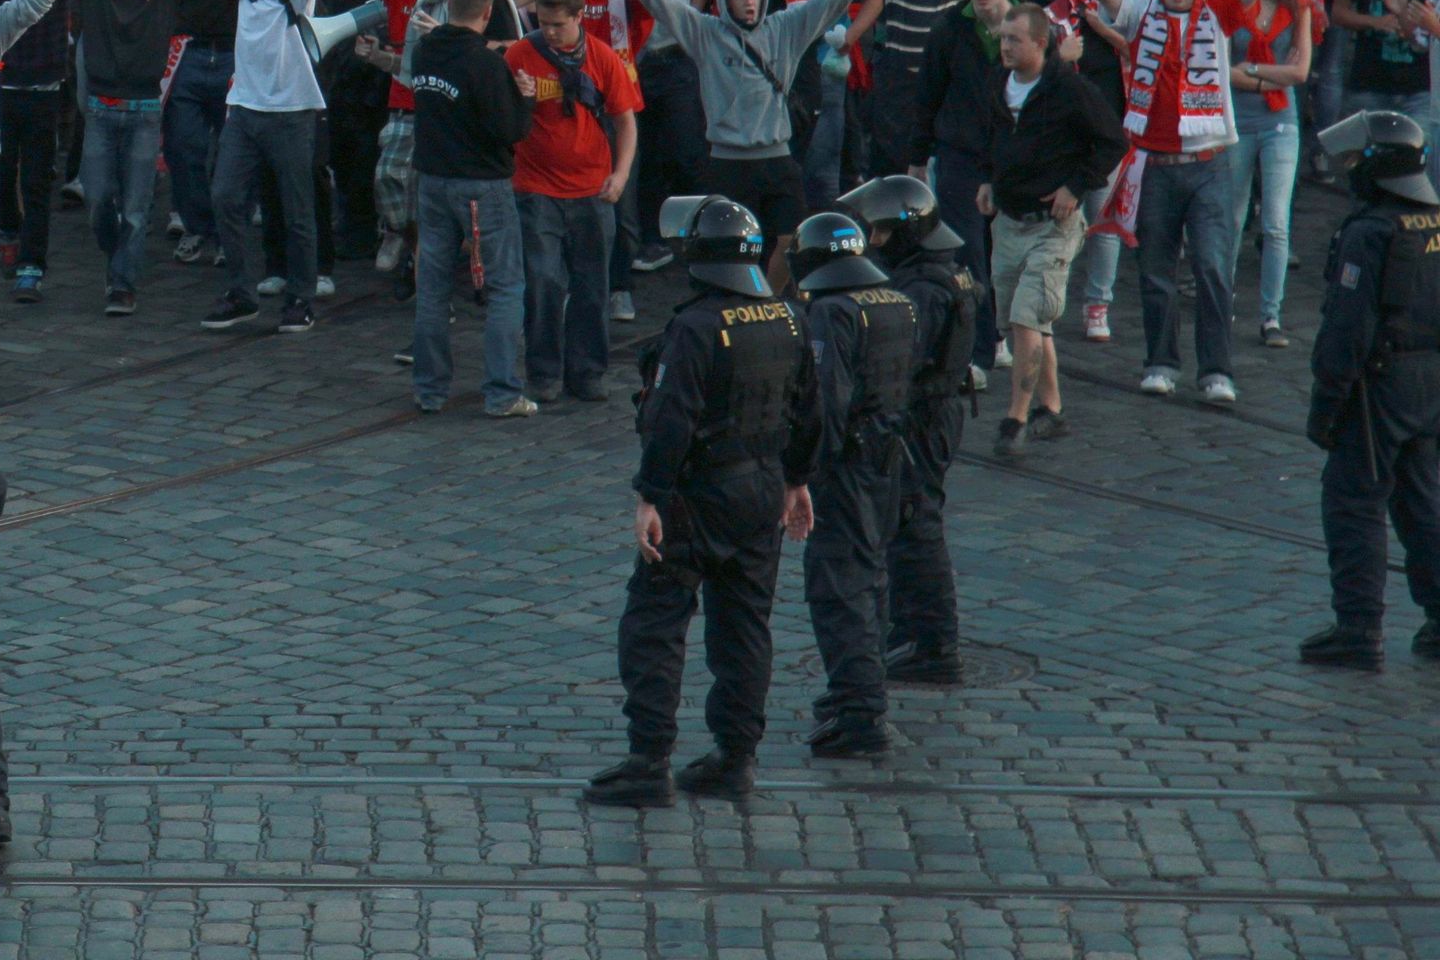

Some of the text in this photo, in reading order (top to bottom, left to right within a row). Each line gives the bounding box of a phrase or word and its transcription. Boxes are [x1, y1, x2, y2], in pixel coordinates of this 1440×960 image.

[740, 242, 748, 253] B
[830, 238, 864, 252] B 964
[721, 302, 788, 326] POLICIE
